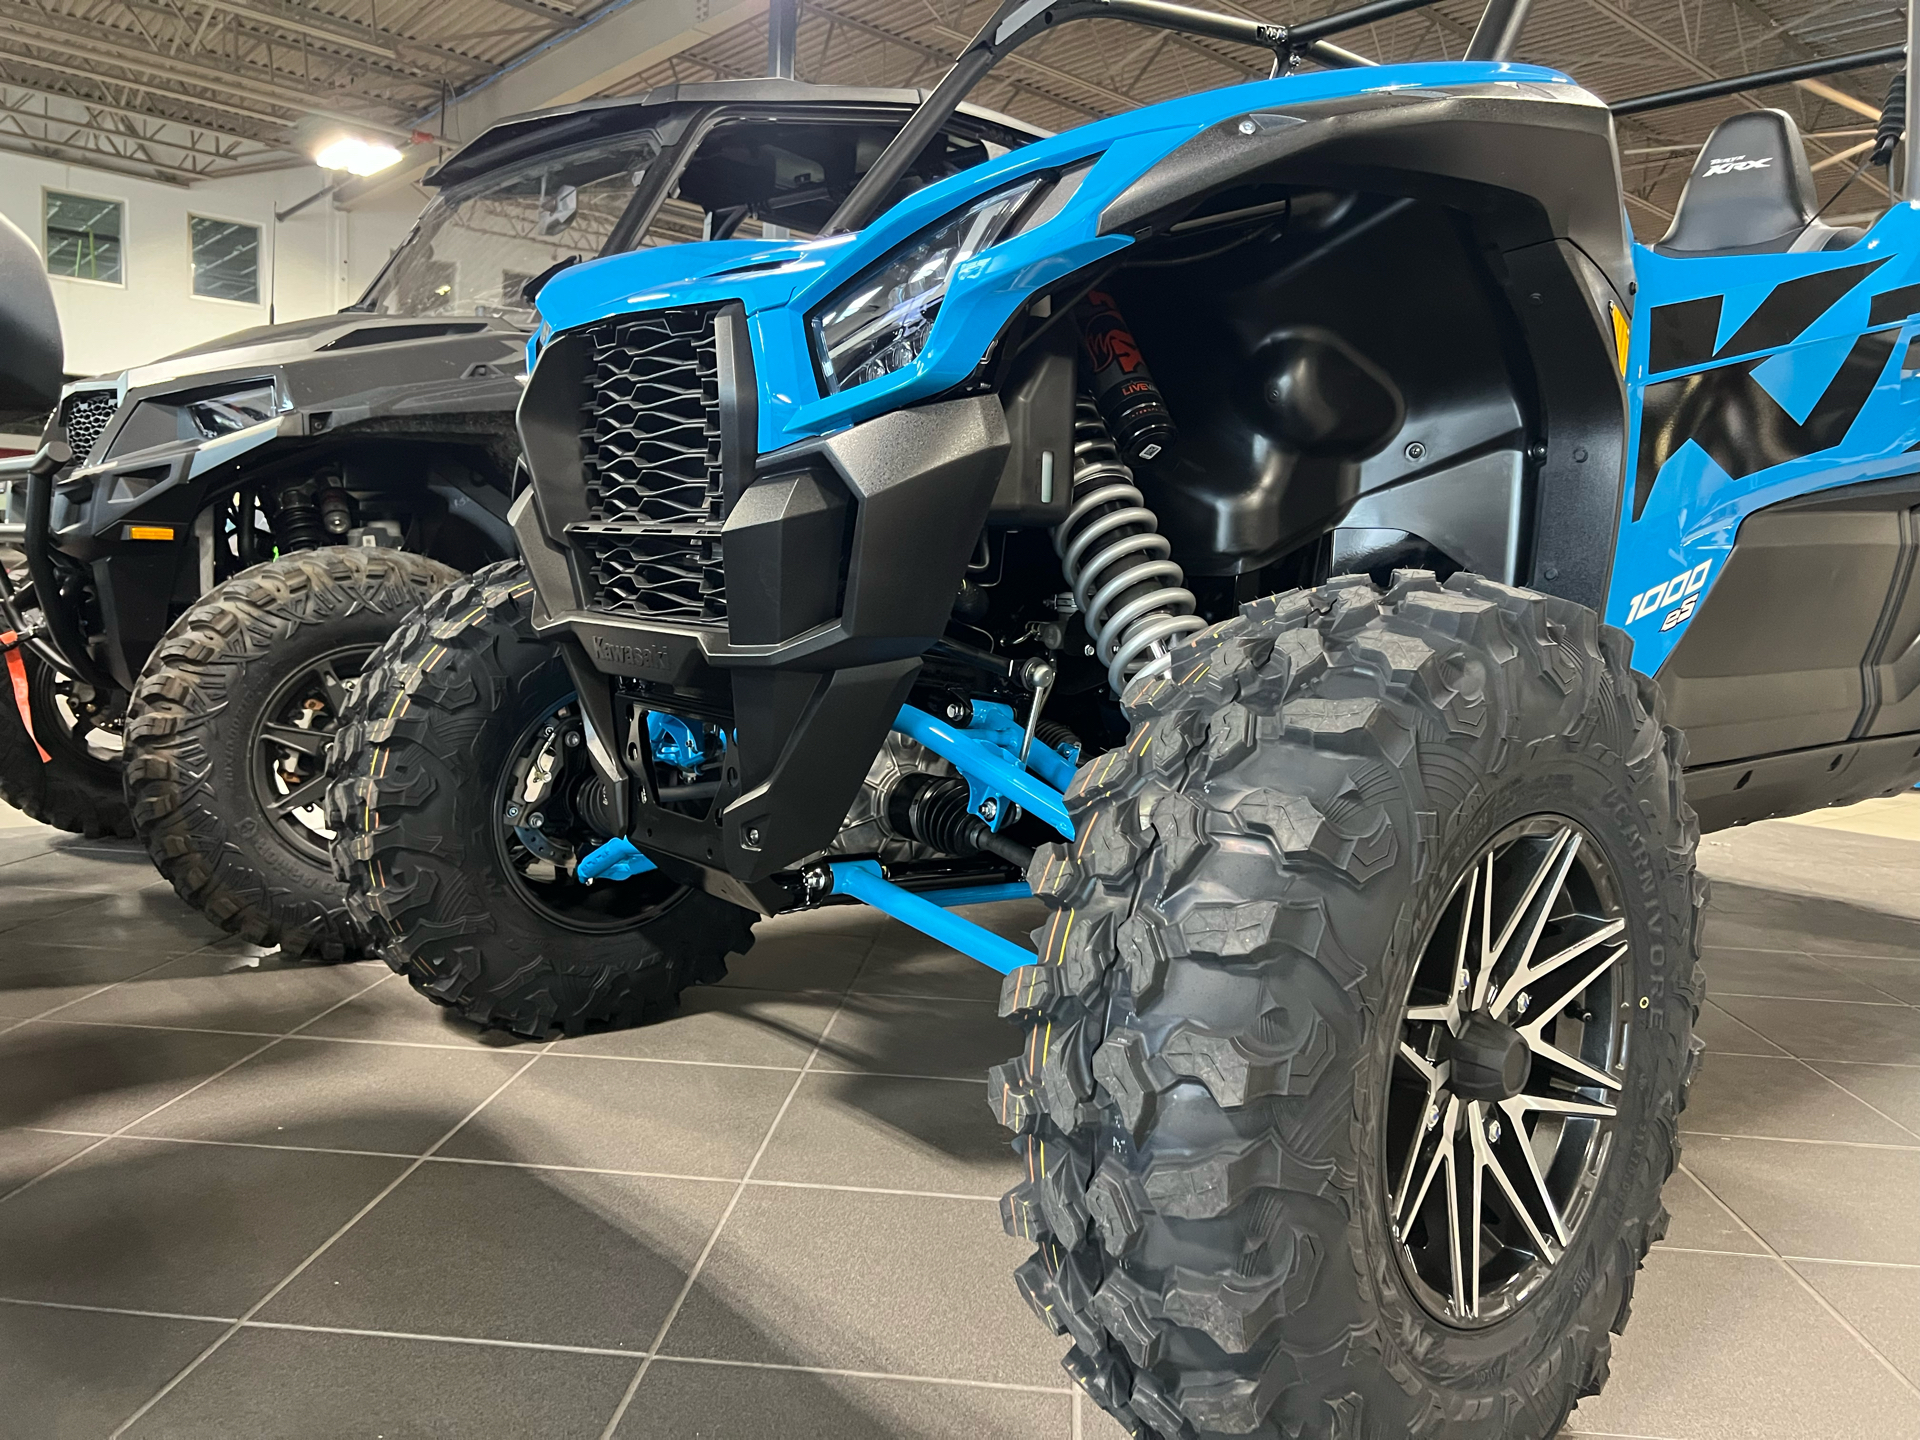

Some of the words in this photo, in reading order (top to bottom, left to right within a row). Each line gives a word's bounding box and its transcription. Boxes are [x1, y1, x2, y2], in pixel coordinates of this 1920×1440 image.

[1702, 156, 1774, 178] KRX
[1625, 558, 1713, 626] 1000
[592, 635, 671, 671] Kawasaki
